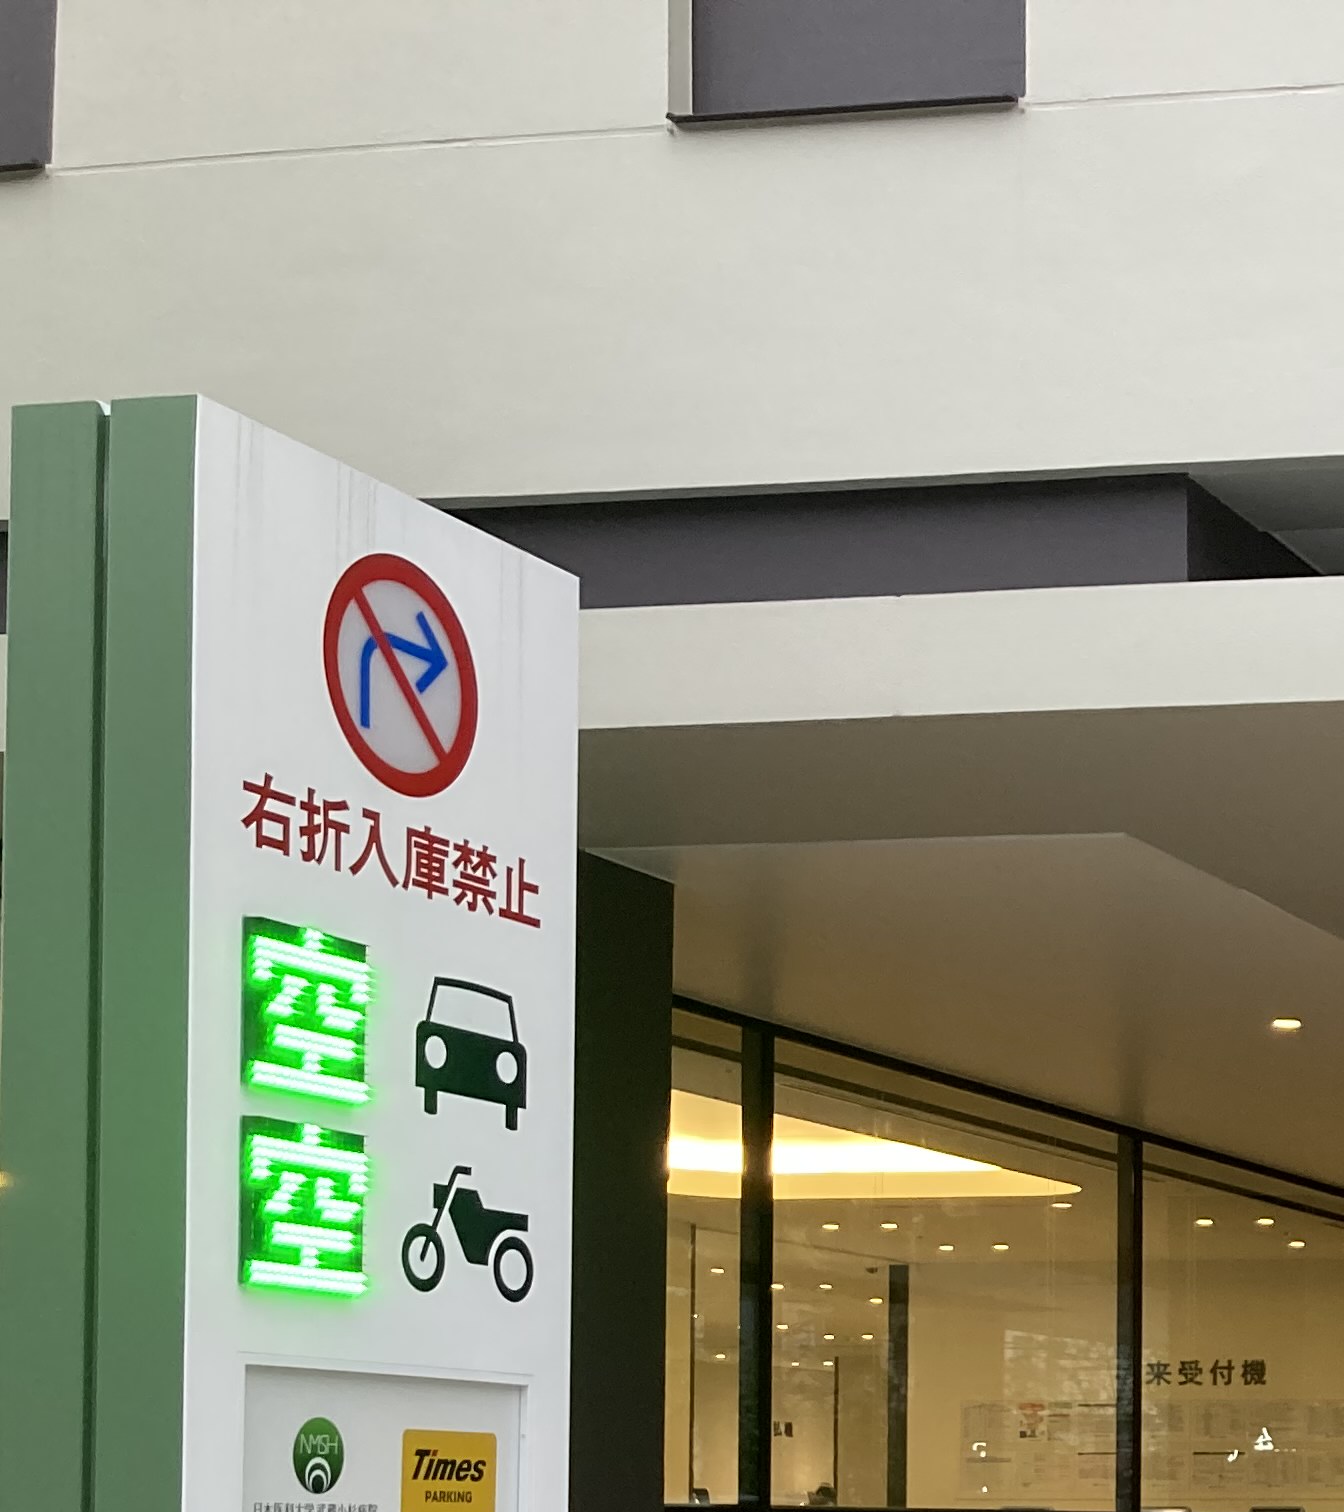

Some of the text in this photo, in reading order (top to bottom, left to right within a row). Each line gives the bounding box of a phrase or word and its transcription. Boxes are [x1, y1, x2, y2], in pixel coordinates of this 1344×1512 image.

[240, 772, 541, 929] 右折入庫禁止
[250, 926, 373, 1105] 空
[248, 1121, 369, 1296] 空
[411, 1449, 487, 1482] Times
[424, 1491, 473, 1504] PARKING
